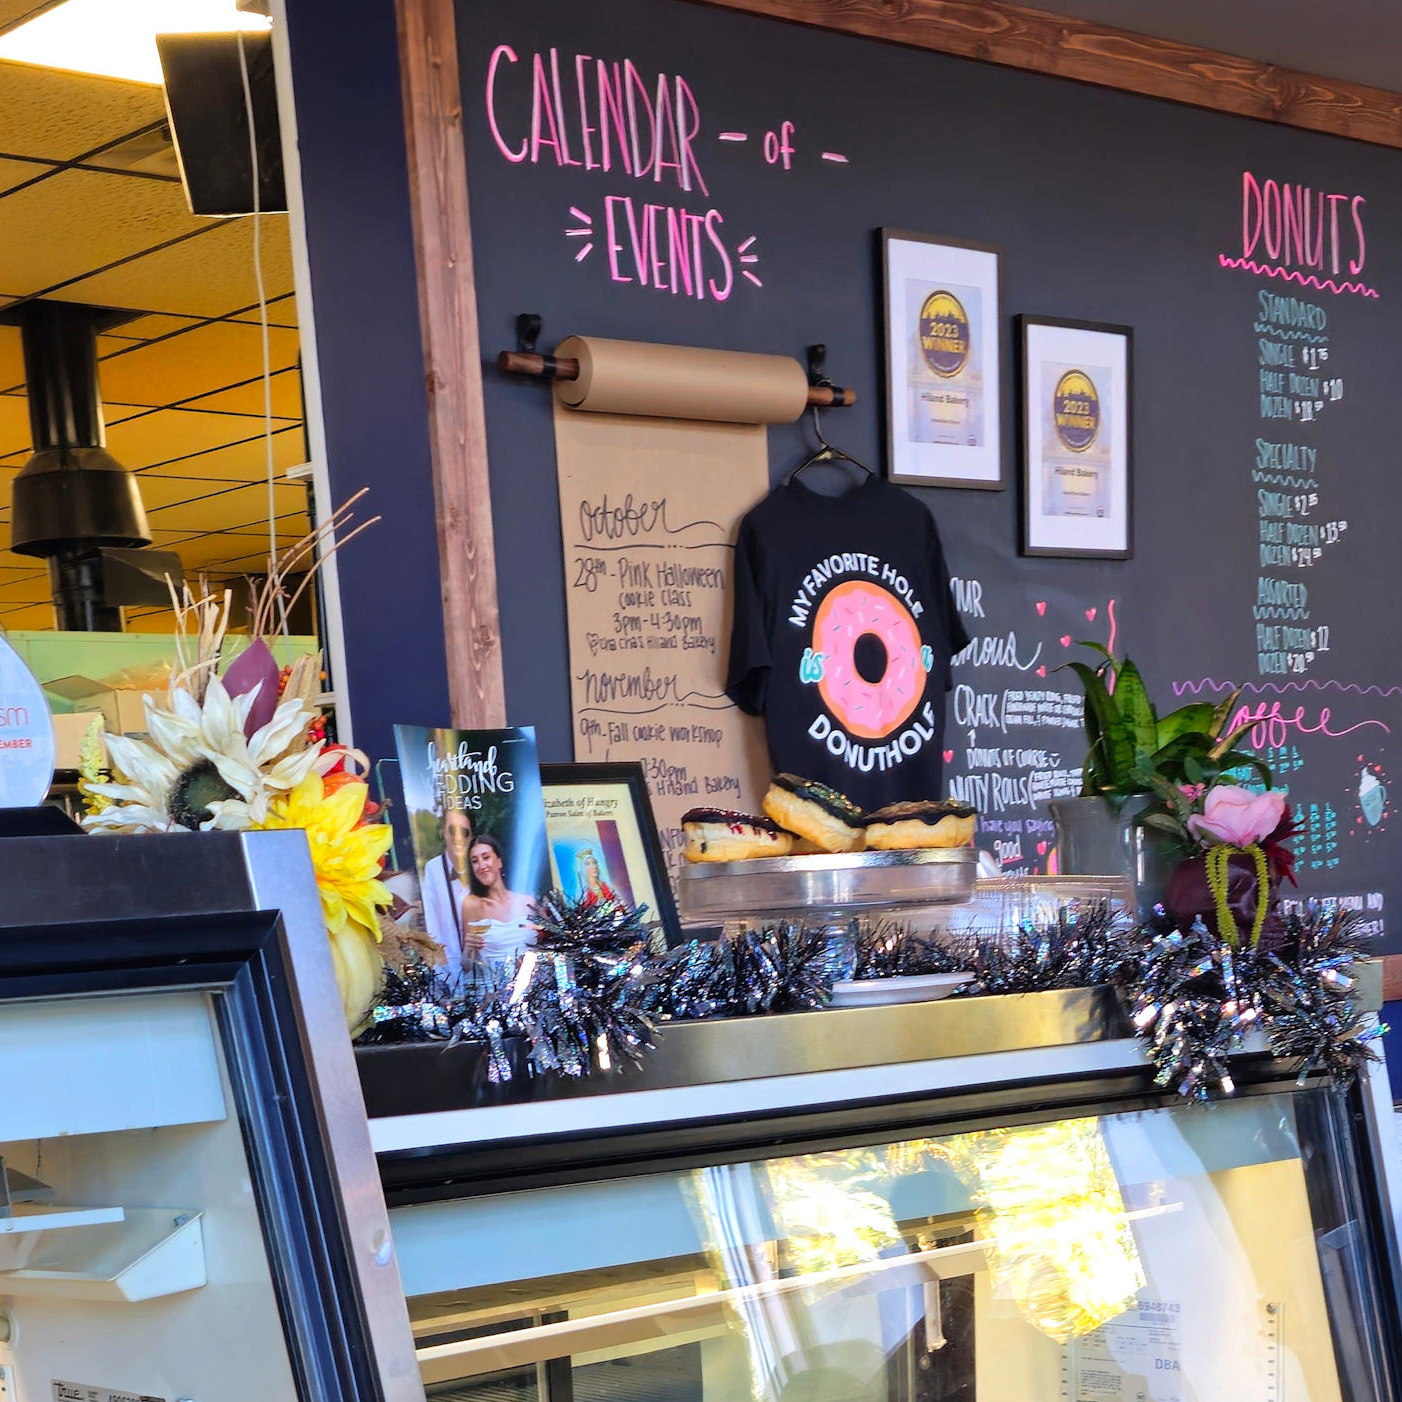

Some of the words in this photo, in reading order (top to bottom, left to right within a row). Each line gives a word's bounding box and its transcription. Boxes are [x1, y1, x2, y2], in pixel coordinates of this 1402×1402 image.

[486, 45, 709, 197] CALENDAR
[764, 121, 795, 170] of
[1242, 171, 1366, 276] DONUTS
[605, 195, 733, 301] EVENTS
[1258, 289, 1327, 331] STANDARD
[922, 336, 966, 352] WINNER
[930, 321, 960, 338] 2023
[1260, 368, 1285, 394] HALF
[1056, 413, 1095, 429] WINNER
[1063, 399, 1090, 415] 2023
[1255, 437, 1317, 472] SPECIALTY
[1258, 489, 1294, 518] SINGLE
[1259, 520, 1285, 544] HALF
[618, 557, 652, 588] Pink
[656, 561, 725, 590] Halloween
[619, 591, 655, 610] cookie
[661, 589, 692, 607] class
[788, 590, 813, 627] MY
[802, 552, 881, 596] FAVORITE
[881, 563, 925, 619] HOLE
[1257, 576, 1307, 608] ASSORTED
[1256, 623, 1281, 650] HALF
[799, 647, 824, 684] is
[954, 684, 1000, 728] CRACK
[608, 721, 629, 744] Fall
[435, 772, 515, 794] EDDING
[949, 772, 989, 814] NUTTY
[991, 772, 1028, 812] ROLLS
